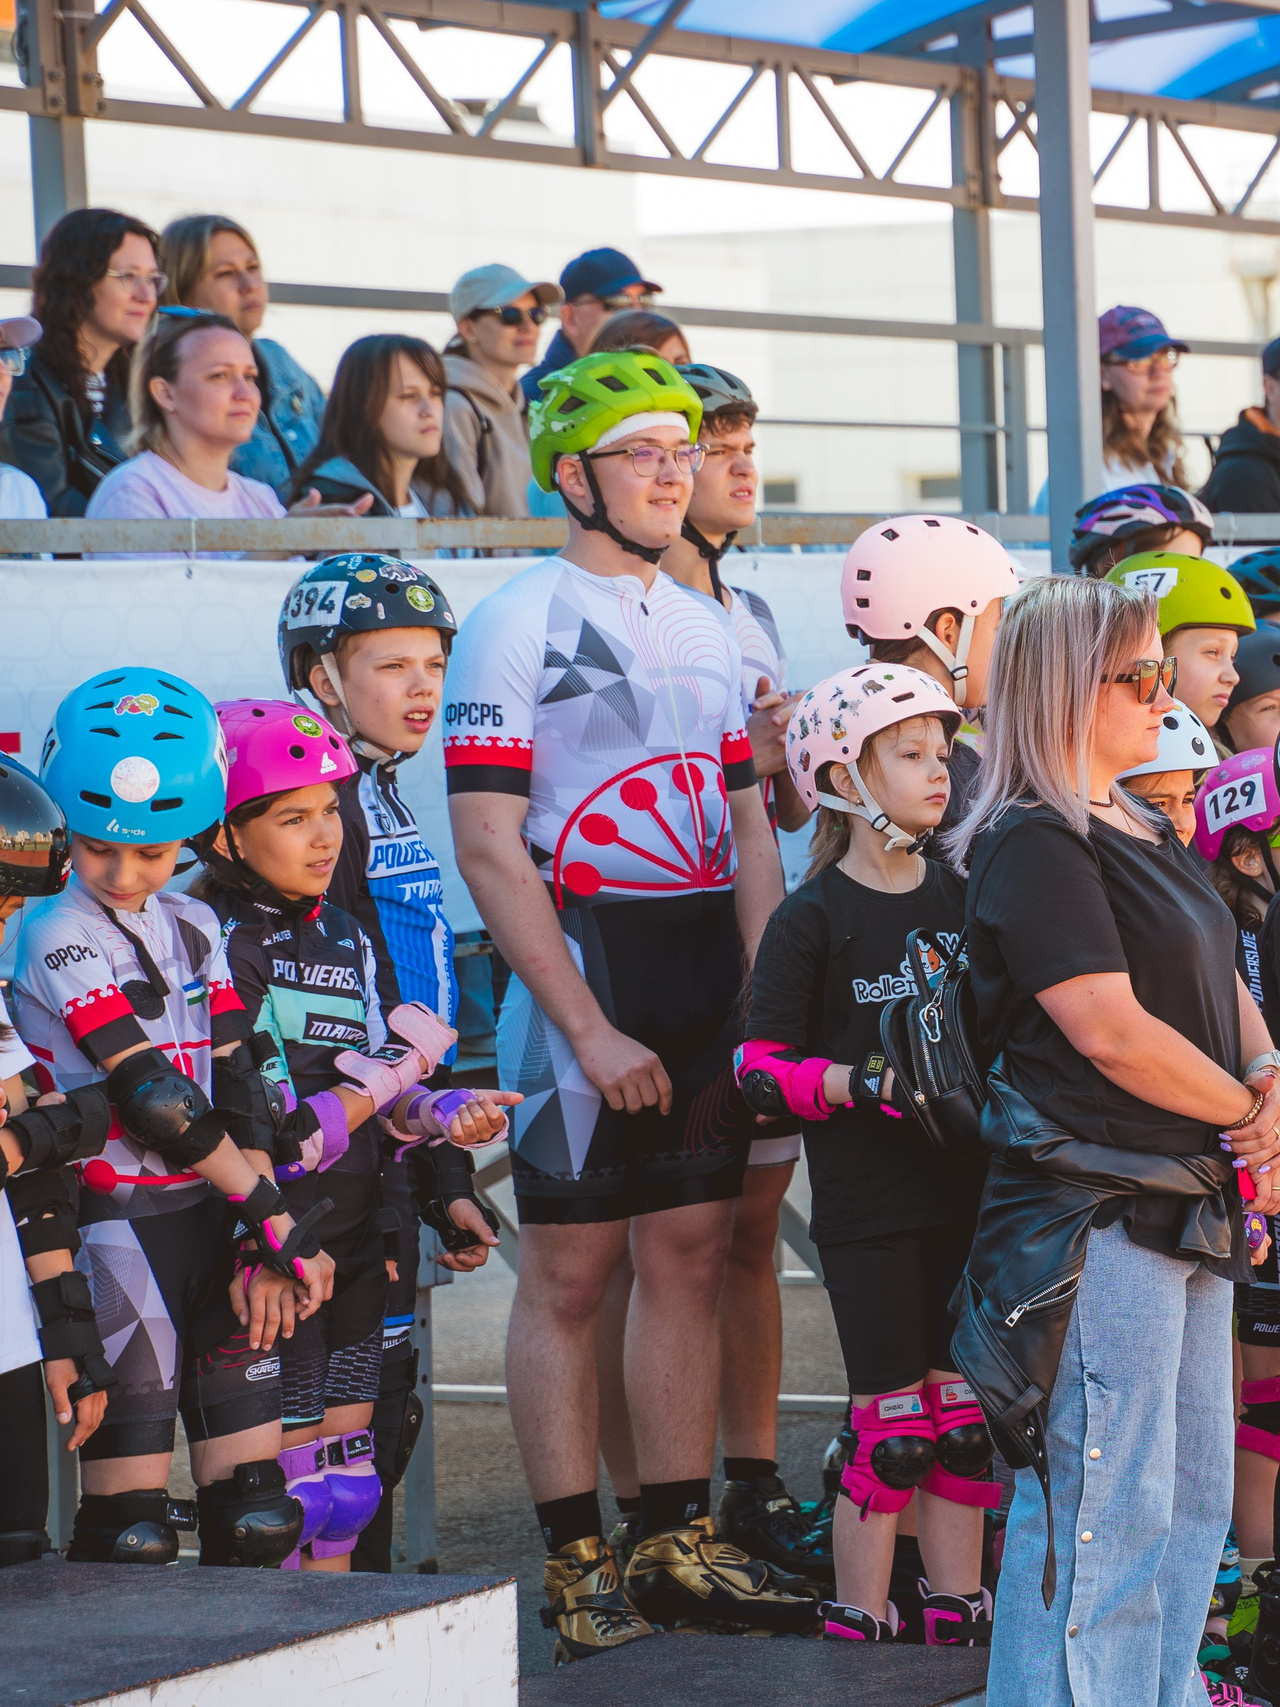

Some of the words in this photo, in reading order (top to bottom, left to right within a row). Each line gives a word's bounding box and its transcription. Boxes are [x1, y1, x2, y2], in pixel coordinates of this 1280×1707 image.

[445, 702, 504, 727] ФРСРБ
[1209, 780, 1257, 820] 129
[855, 977, 917, 999] Roller
